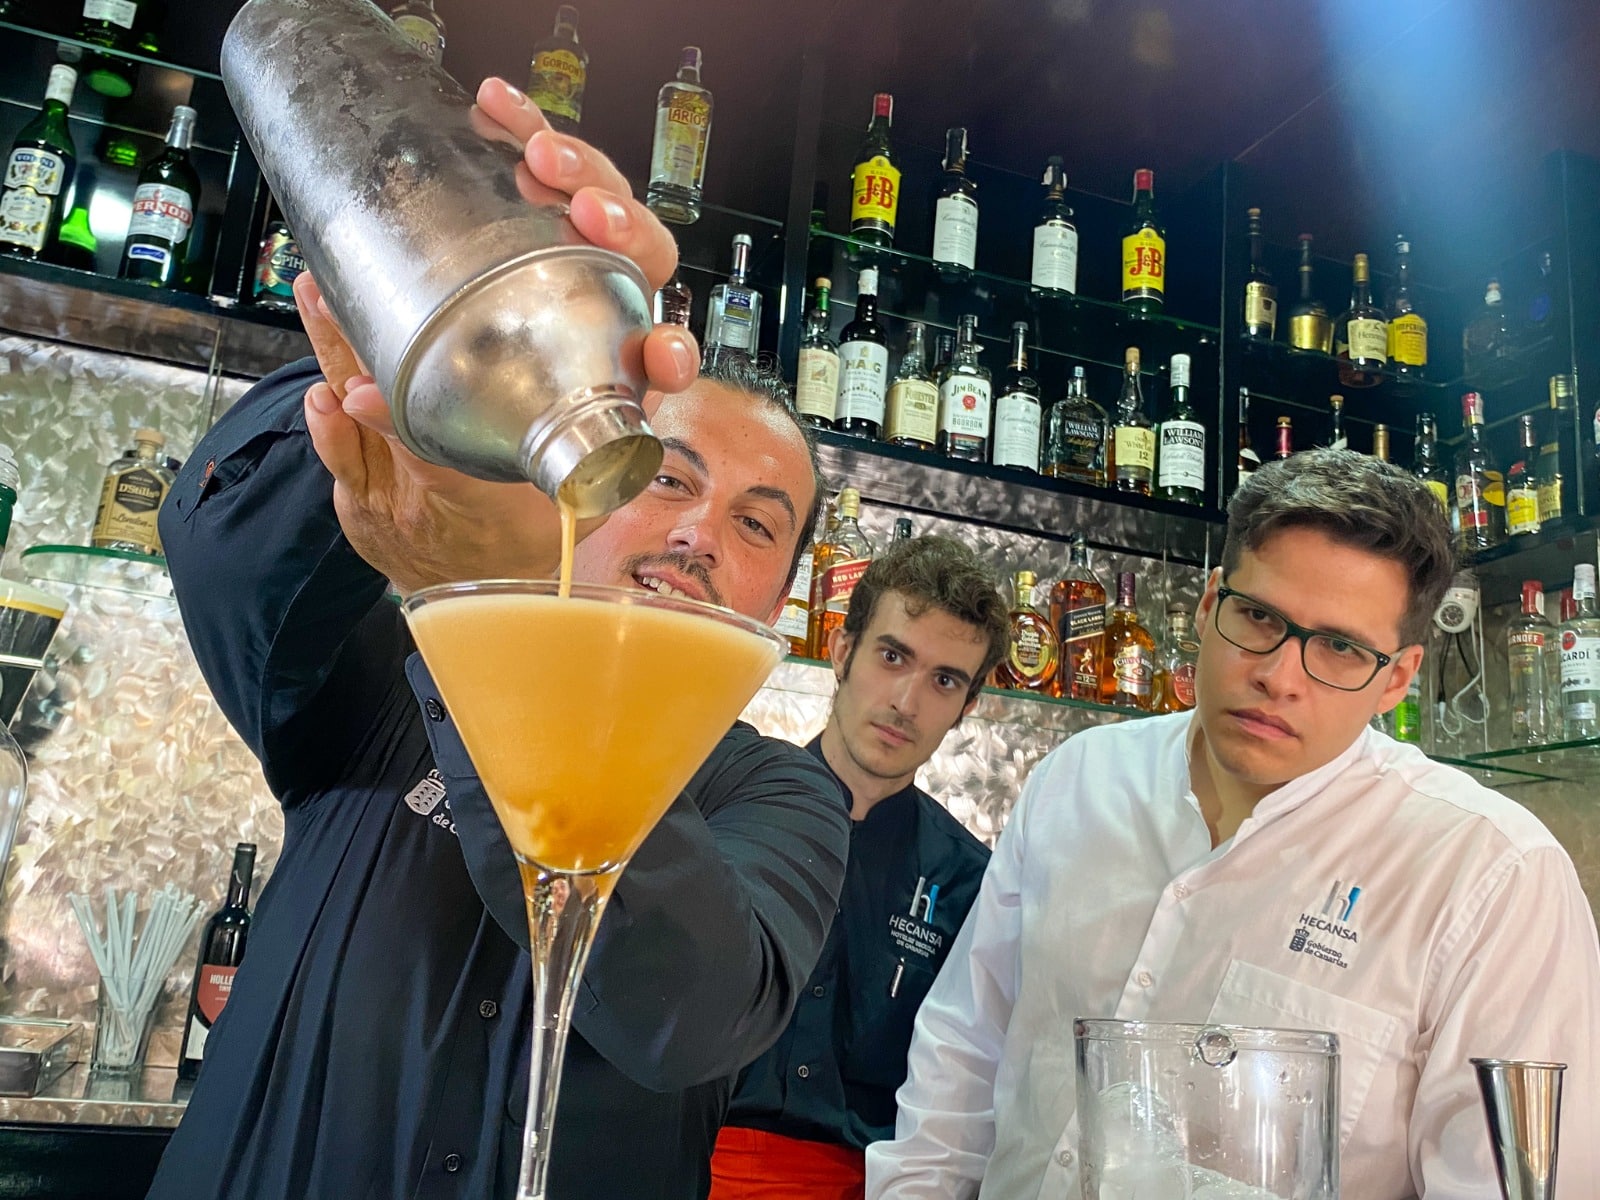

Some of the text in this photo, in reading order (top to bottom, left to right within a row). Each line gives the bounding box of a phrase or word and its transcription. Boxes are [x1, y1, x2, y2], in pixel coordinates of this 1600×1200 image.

[668, 107, 708, 129] LARIOS
[858, 175, 894, 209] J&B
[1129, 246, 1162, 278] J&B
[951, 383, 988, 402] JIM BEAM
[1139, 450, 1149, 461] 12
[432, 813, 450, 829] de
[889, 914, 943, 949] HECANSA
[1298, 912, 1359, 944] HECANSA
[1303, 946, 1349, 969] de Canarias
[1306, 939, 1343, 959] Gobierno
